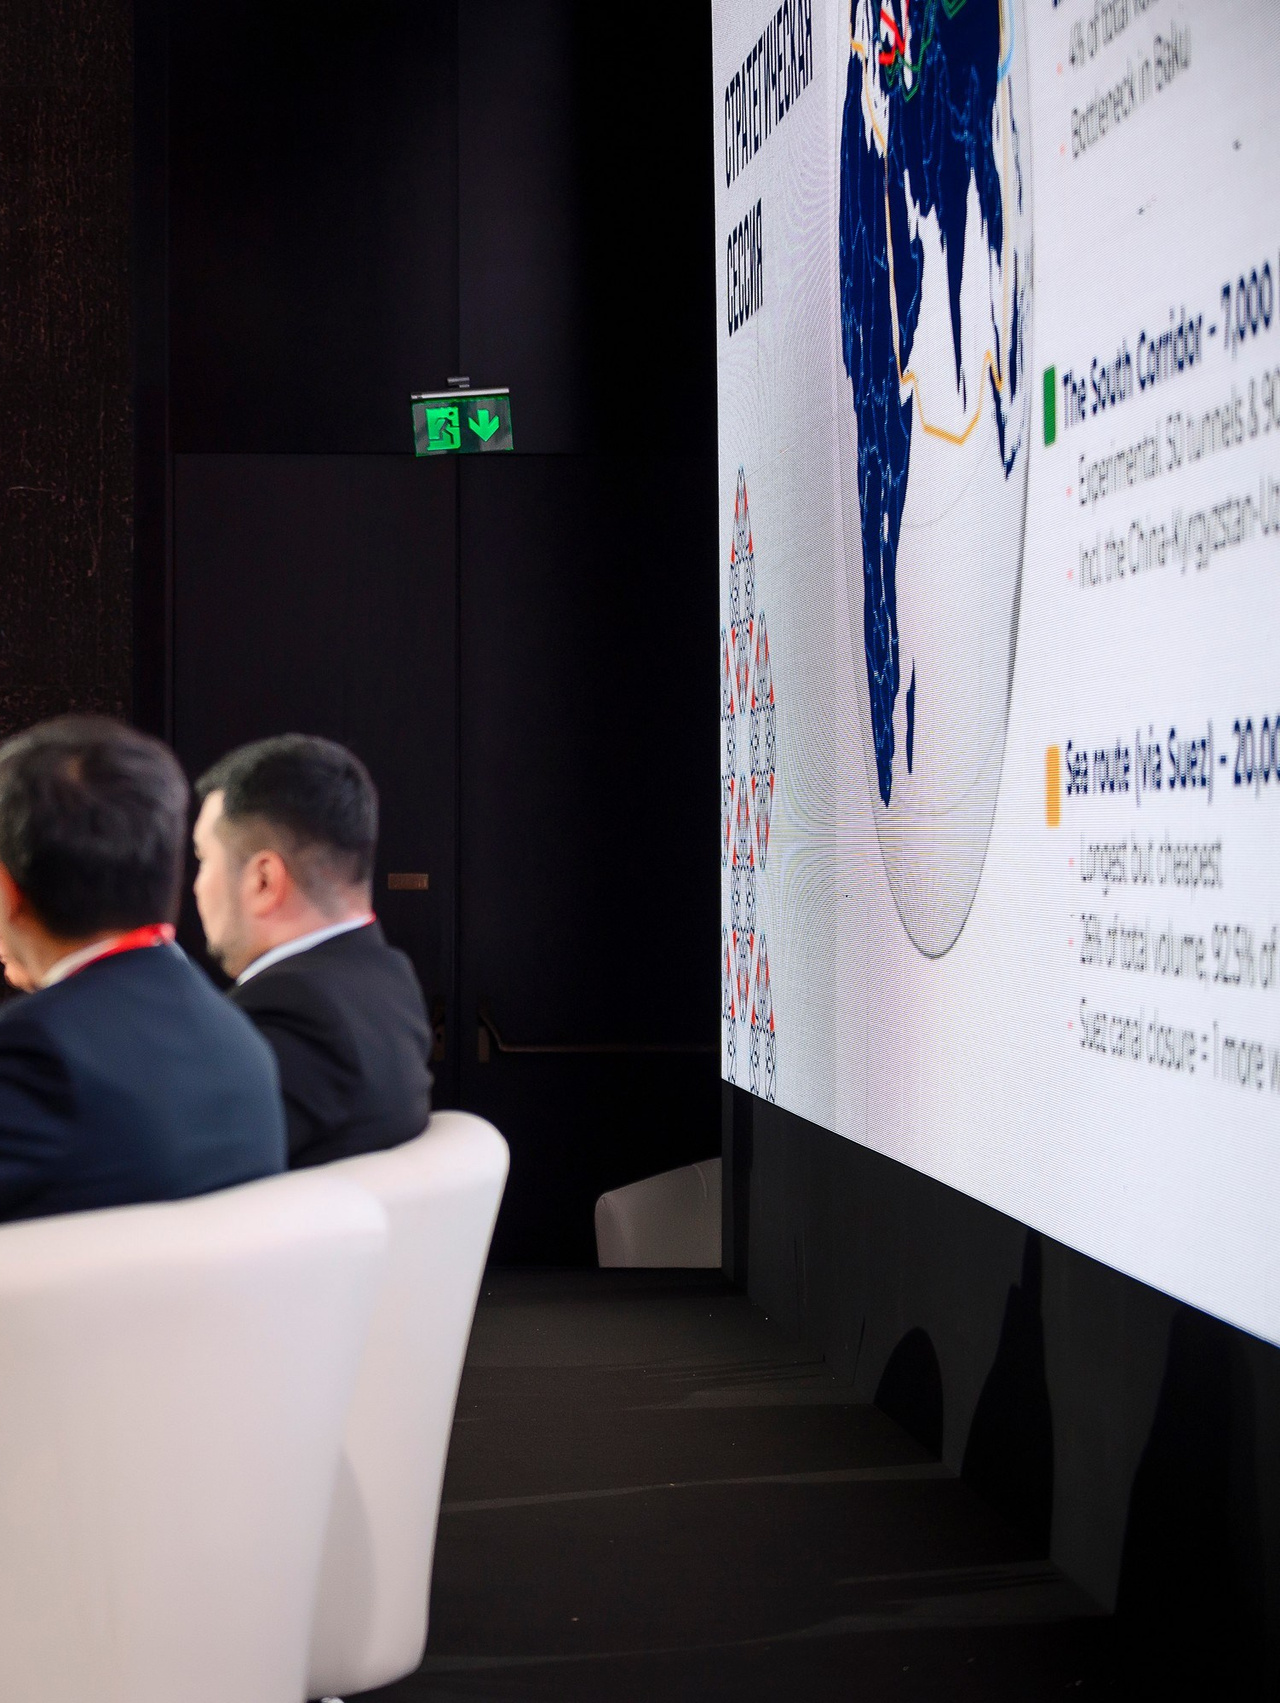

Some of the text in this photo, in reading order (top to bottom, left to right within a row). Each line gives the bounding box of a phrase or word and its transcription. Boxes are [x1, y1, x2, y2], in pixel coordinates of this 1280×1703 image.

[1071, 18, 1191, 160] Bottleneck in Baku
[727, 197, 763, 337] СЕССИЯ
[1062, 368, 1087, 430] The
[1090, 337, 1134, 417] South
[1137, 303, 1204, 394] Corridor
[1221, 260, 1273, 361] 7,000
[1187, 384, 1243, 461] tunnels
[1248, 377, 1259, 438] &
[1104, 526, 1126, 581] the
[1066, 739, 1088, 796] Sea
[1092, 736, 1130, 794] route
[1135, 724, 1162, 808] (via
[1167, 718, 1214, 806] Suez)
[1080, 829, 1223, 898] Longest but cheapest
[1105, 912, 1118, 967] of
[1119, 914, 1149, 974] total
[1259, 924, 1277, 990] of
[1080, 996, 1108, 1054] Suez
[1110, 1004, 1144, 1061] canal
[1146, 1006, 1196, 1074] closure
[1221, 1035, 1265, 1090] more
